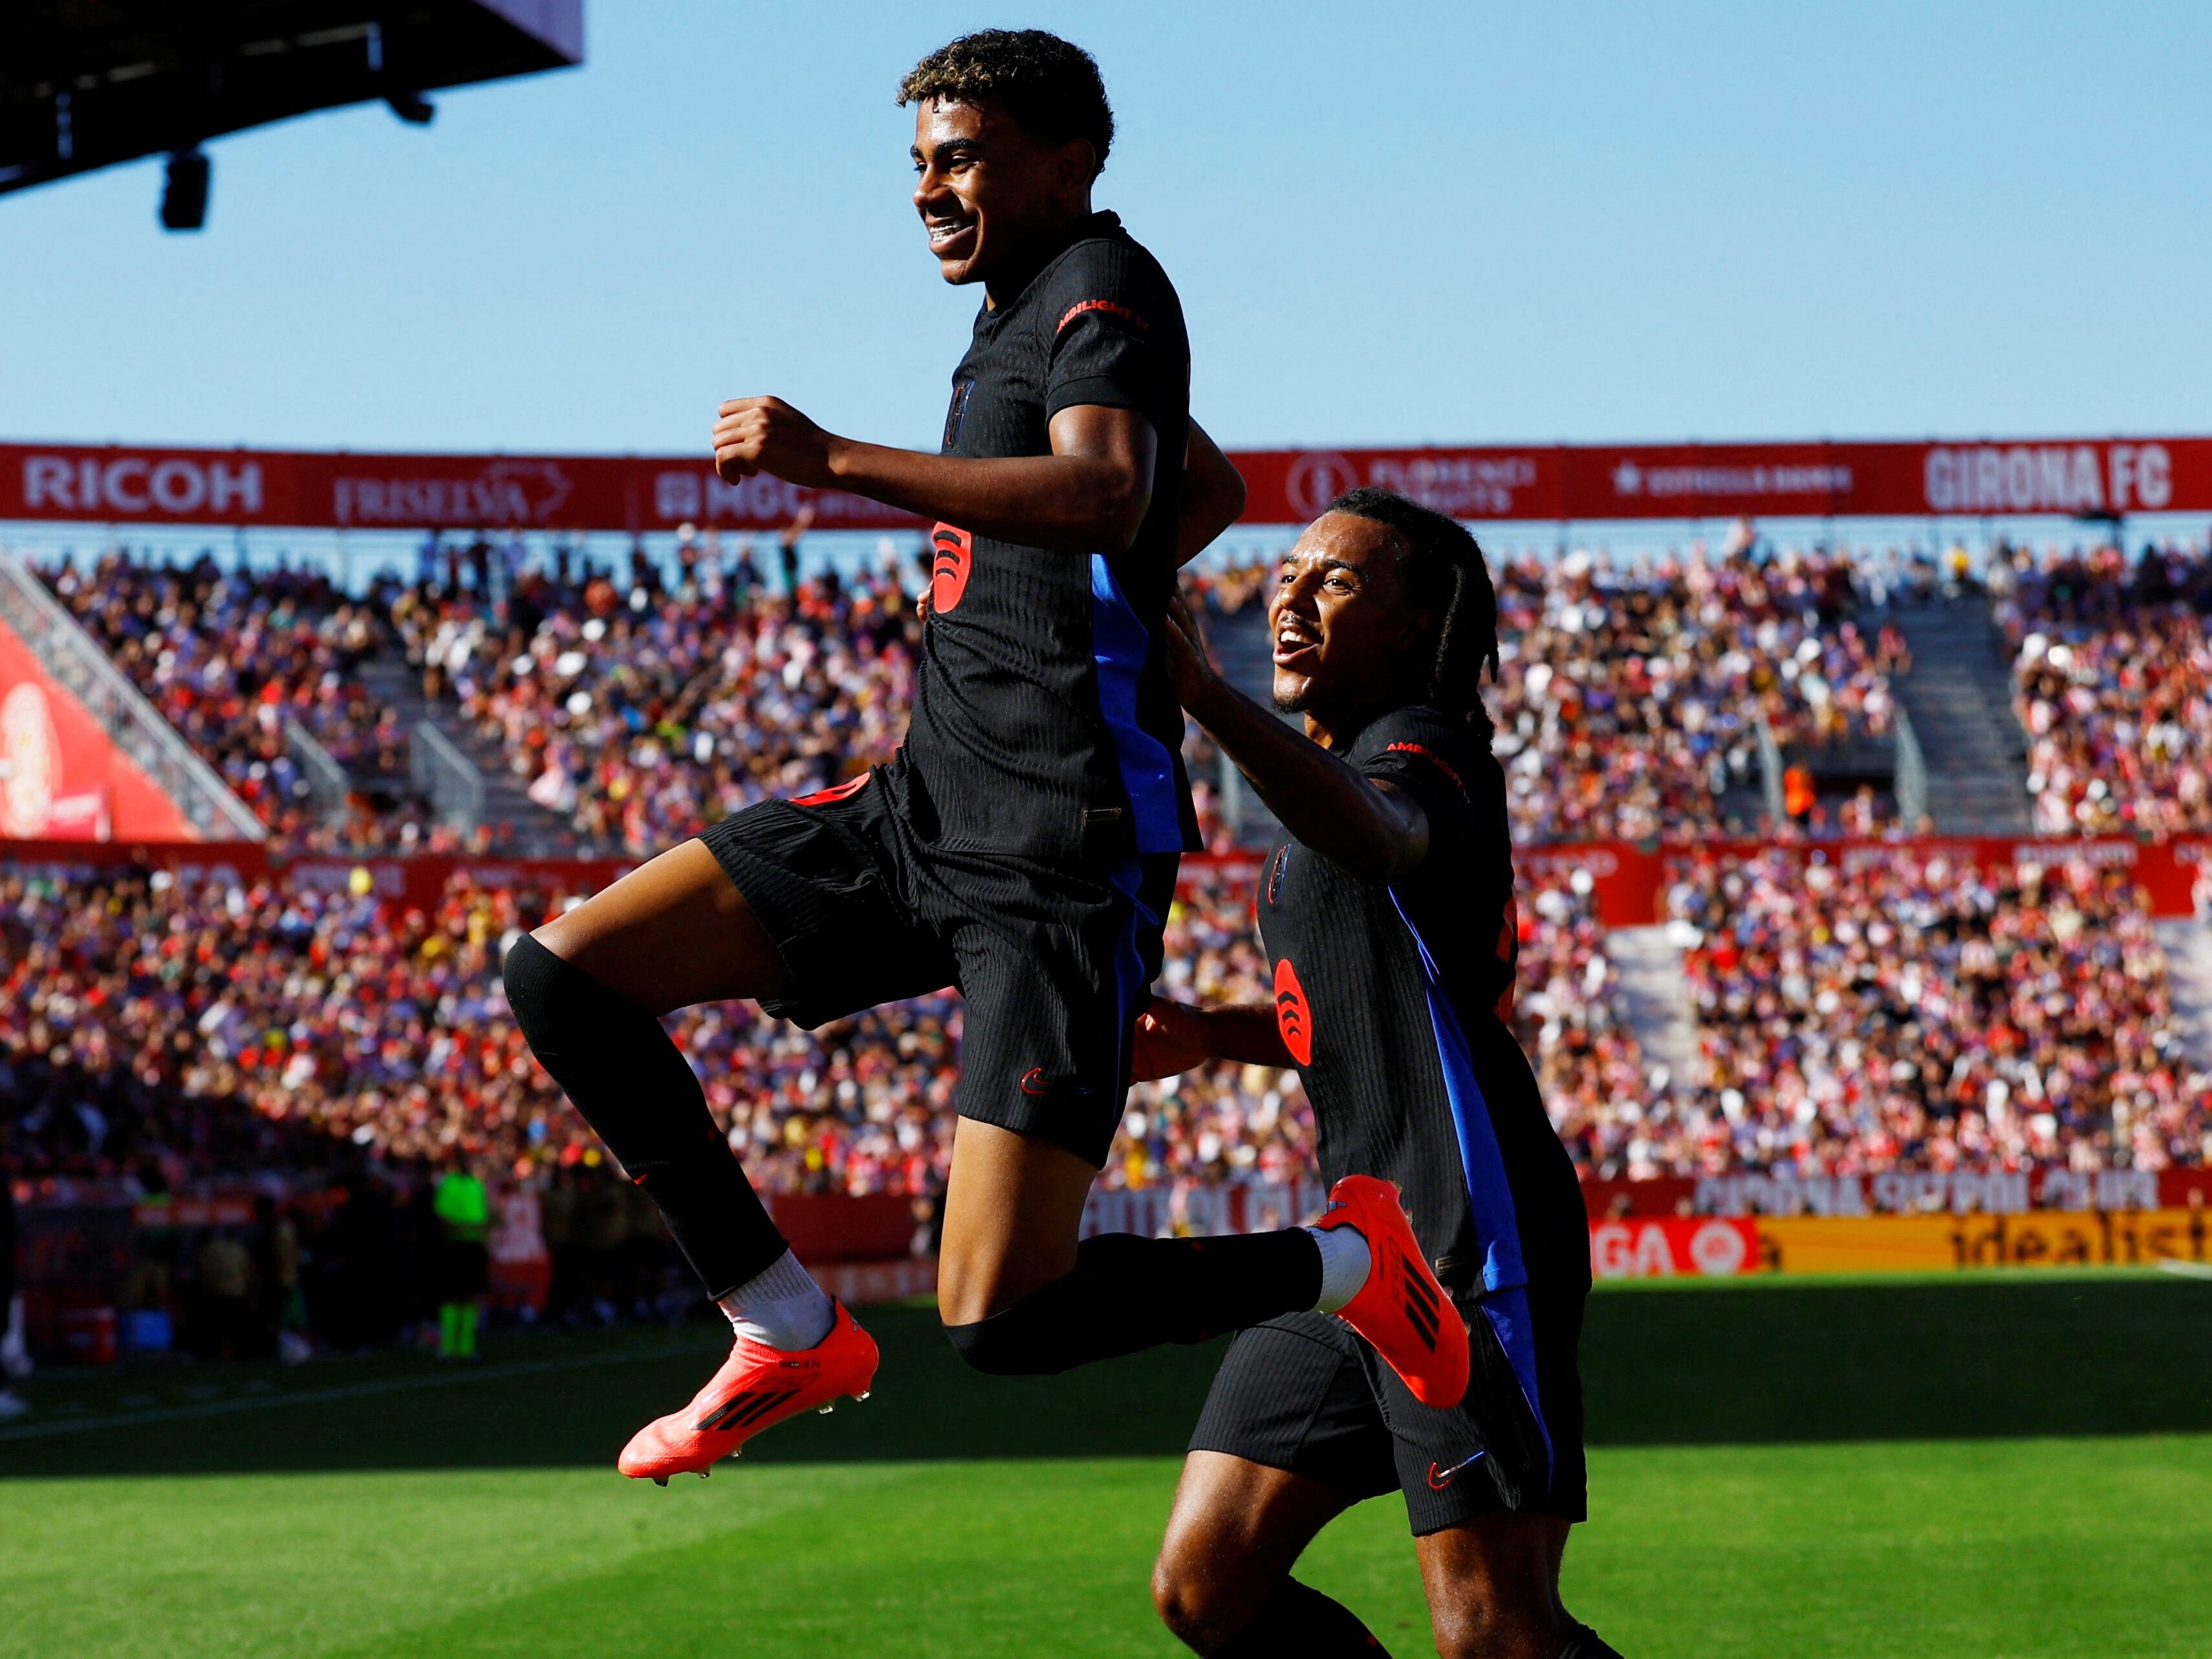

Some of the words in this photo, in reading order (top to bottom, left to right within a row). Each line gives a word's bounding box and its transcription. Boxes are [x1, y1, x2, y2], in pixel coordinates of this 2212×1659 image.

[21, 456, 263, 514] RICOH
[1924, 446, 2106, 510] GIRONA
[2109, 444, 2171, 508] FC
